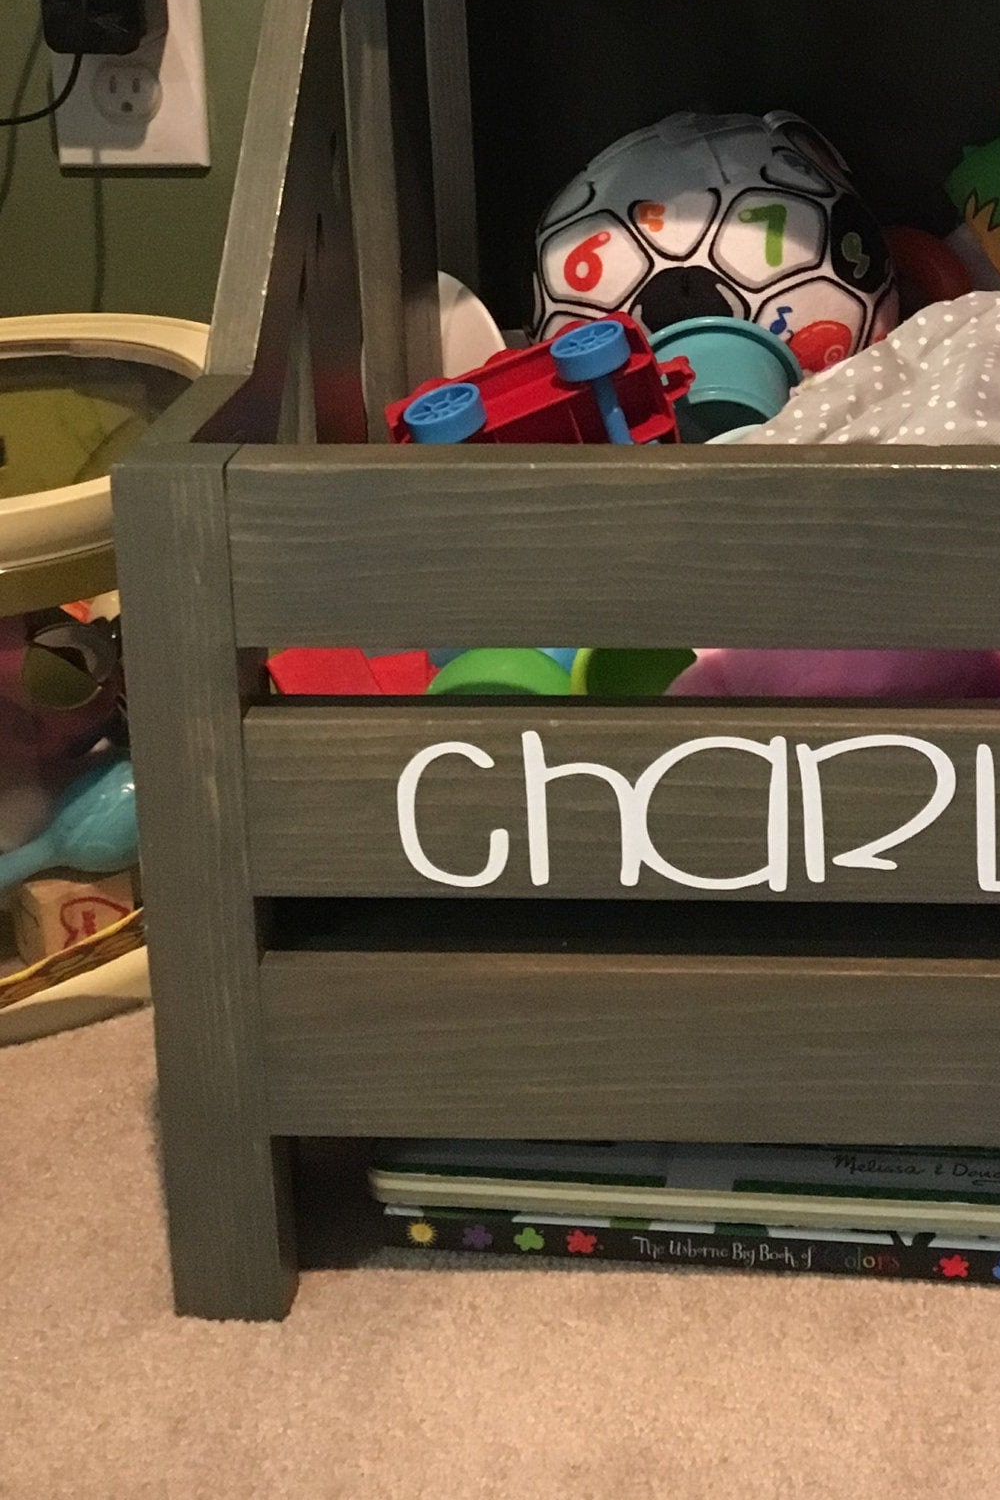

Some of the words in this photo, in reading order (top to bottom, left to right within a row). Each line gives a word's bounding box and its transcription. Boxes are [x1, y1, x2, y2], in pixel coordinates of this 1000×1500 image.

[738, 203, 788, 268] 7
[563, 231, 611, 292] 6
[833, 1152, 926, 1176] Melissa
[632, 1235, 663, 1260] The
[669, 1235, 729, 1259] Usborne
[732, 1242, 756, 1267] Big
[759, 1243, 797, 1269] Book
[800, 1245, 814, 1269] of
